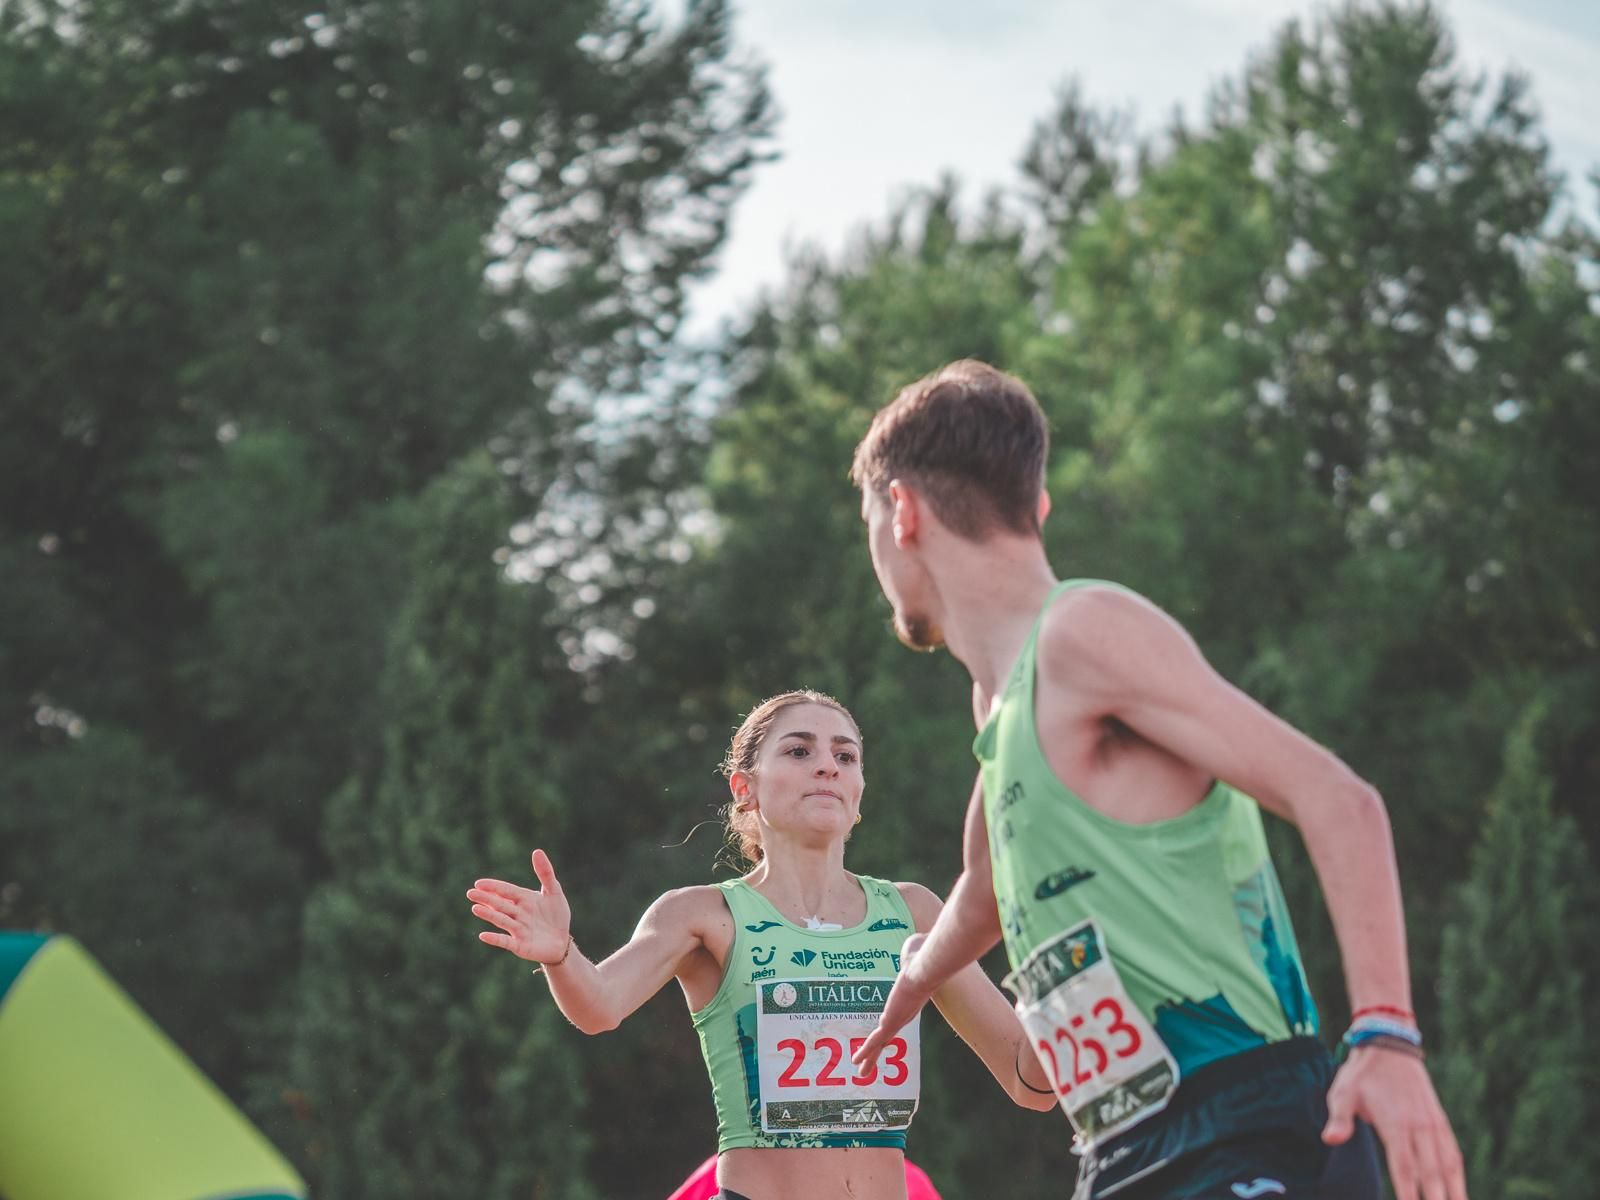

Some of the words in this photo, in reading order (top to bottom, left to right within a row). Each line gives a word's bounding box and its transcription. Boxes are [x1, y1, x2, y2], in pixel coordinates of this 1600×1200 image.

[821, 948, 890, 962] Fundación
[824, 959, 876, 973] Unicaja
[808, 982, 885, 1002] ITÁLICA
[1039, 995, 1142, 1096] 2253
